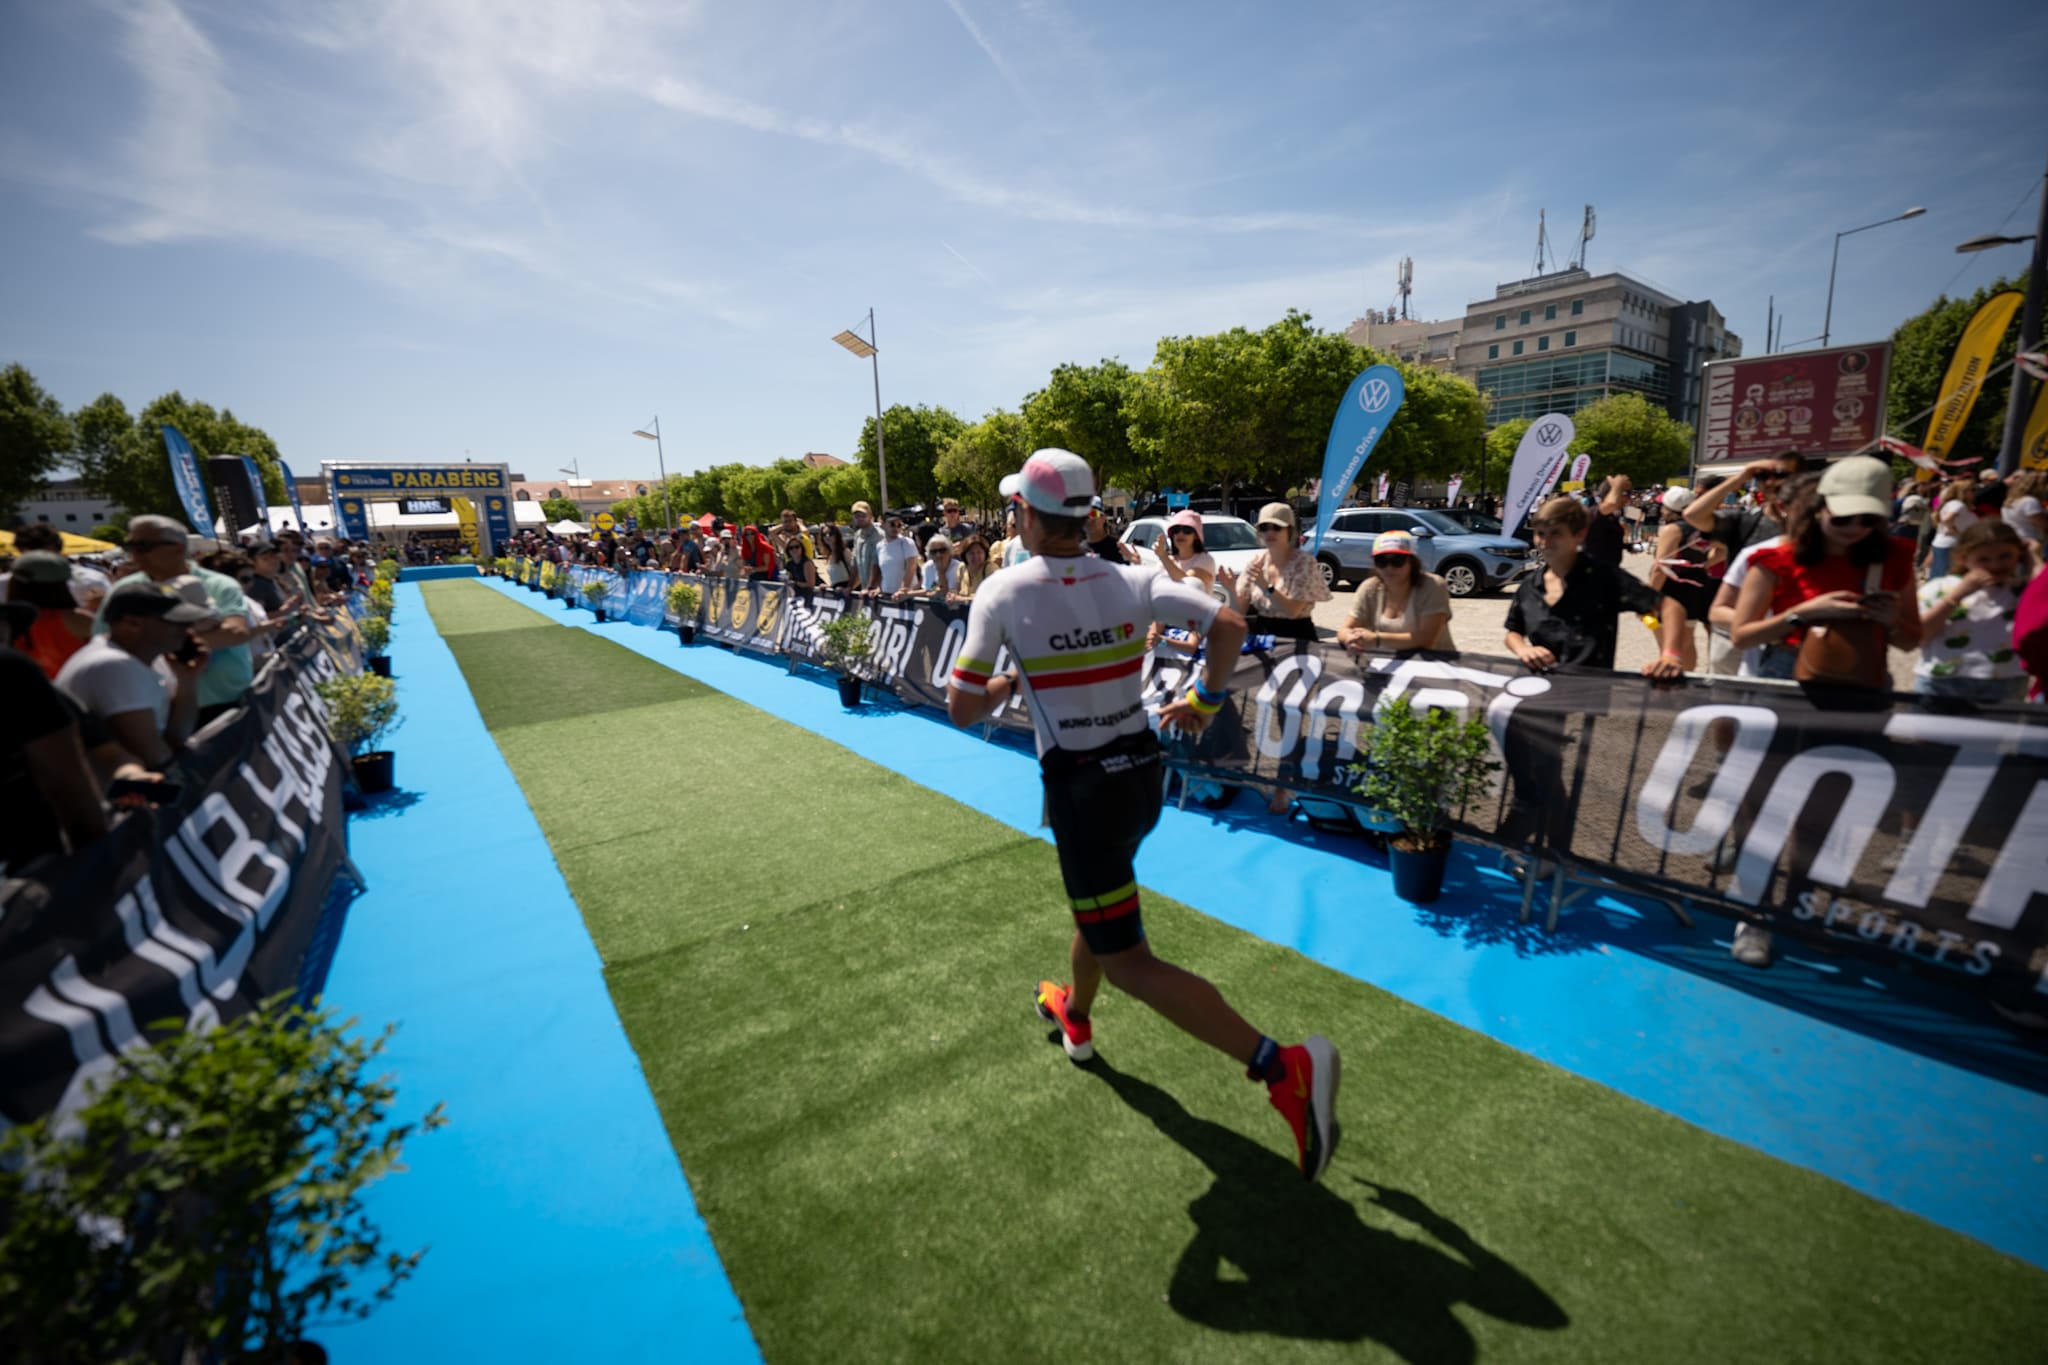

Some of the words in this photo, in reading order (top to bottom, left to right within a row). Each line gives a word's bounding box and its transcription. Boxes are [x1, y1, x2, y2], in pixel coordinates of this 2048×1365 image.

[391, 469, 500, 487] PARABÉNS
[1331, 456, 1360, 497] Caetano
[1355, 426, 1378, 456] Drive
[1516, 478, 1539, 508] Caetano
[1536, 456, 1554, 477] Drive
[1792, 891, 2001, 977] SPORTS
